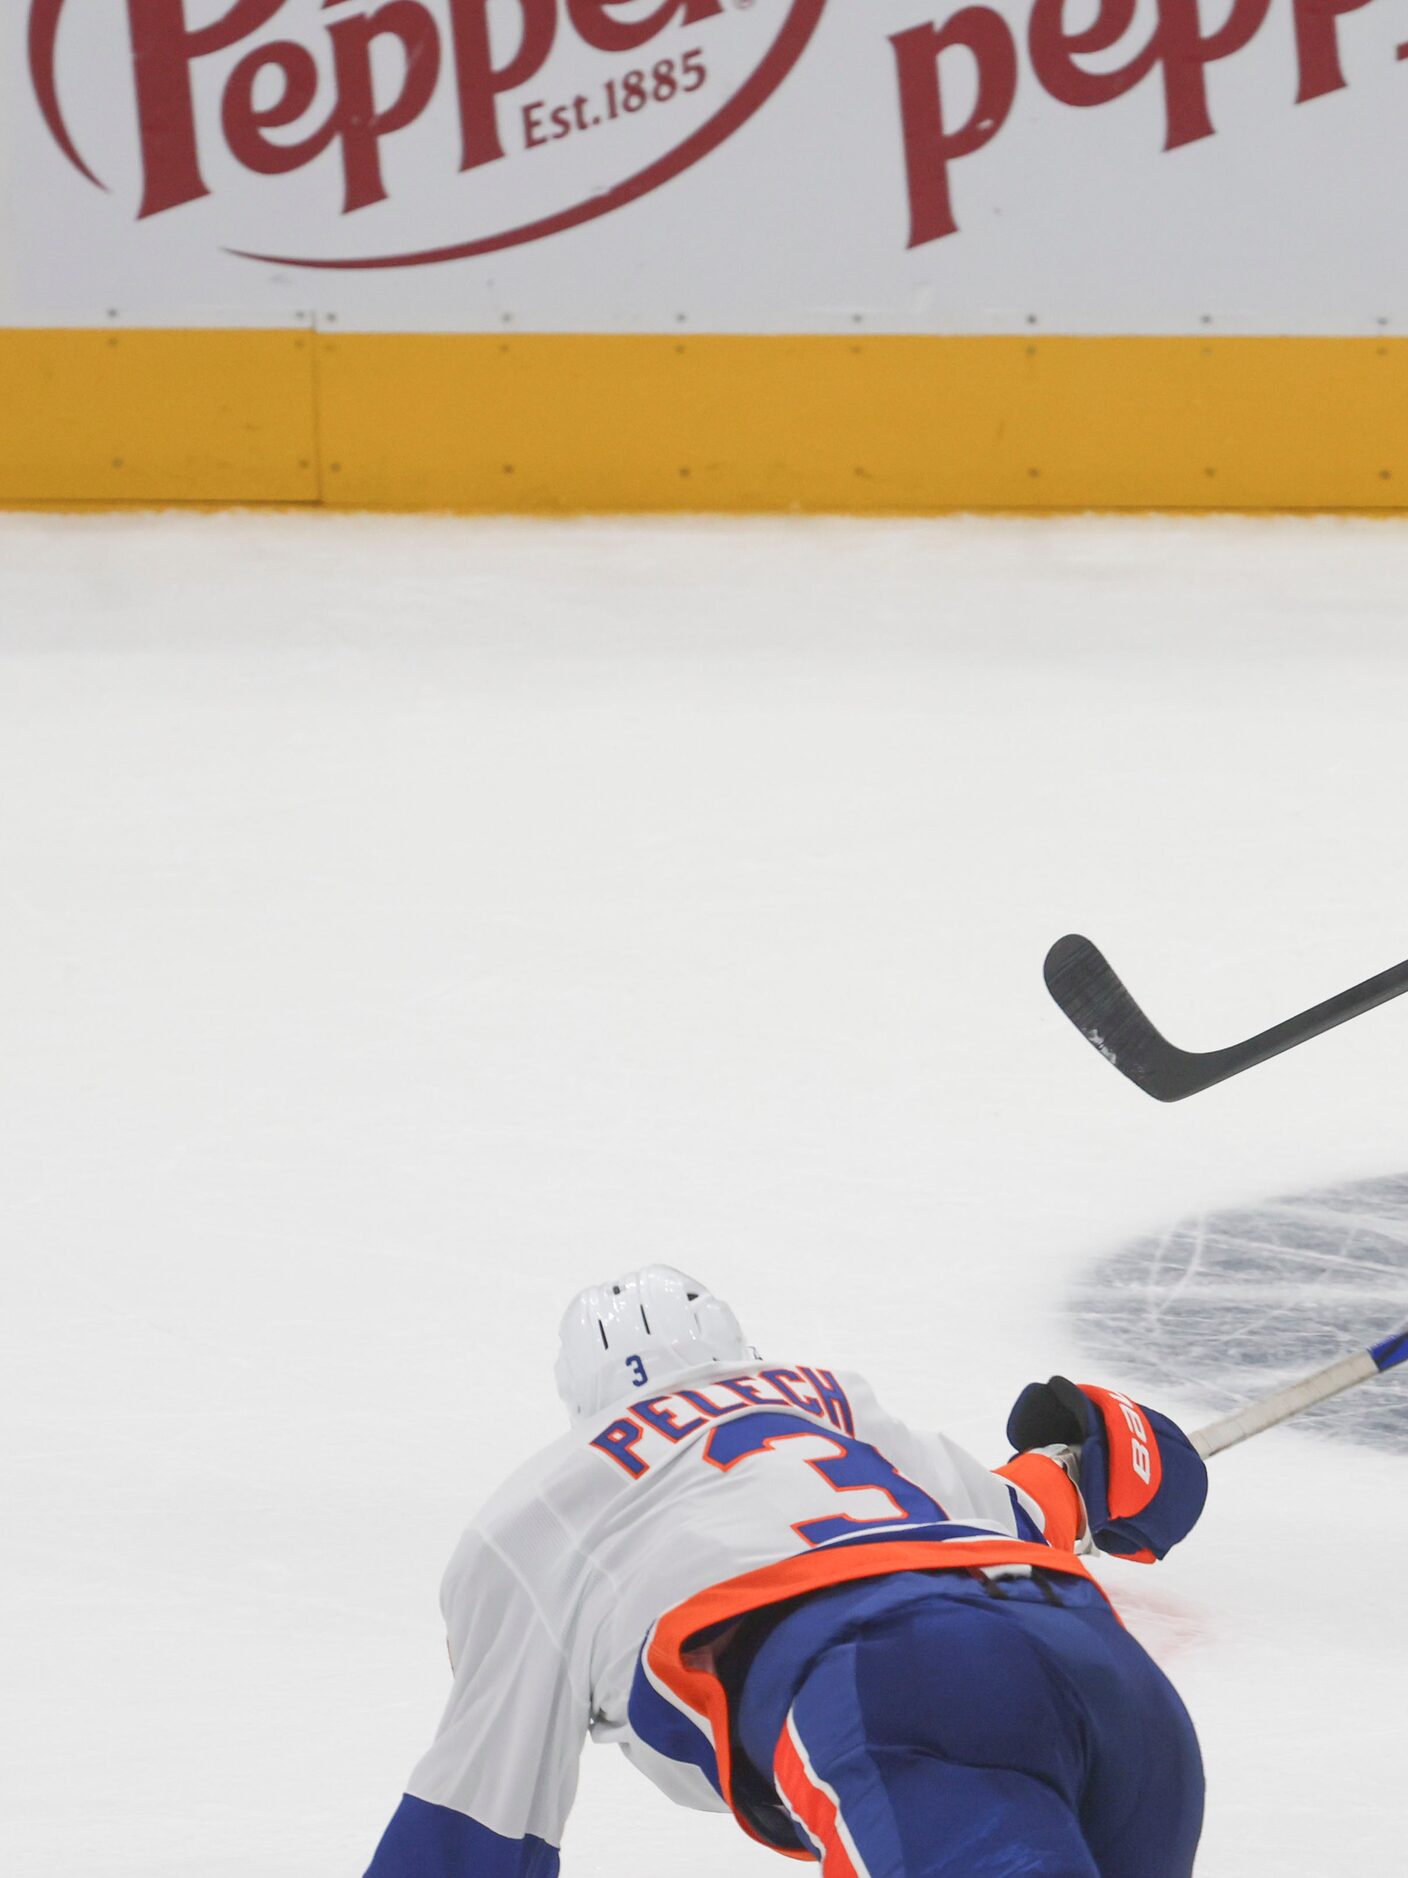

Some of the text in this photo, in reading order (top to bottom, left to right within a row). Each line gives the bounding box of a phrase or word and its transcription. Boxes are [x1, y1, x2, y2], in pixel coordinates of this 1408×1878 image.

[134, 0, 724, 220] Pepp
[588, 1365, 855, 1480] PELECH
[625, 1354, 649, 1387] 3
[702, 1411, 950, 1547] 3
